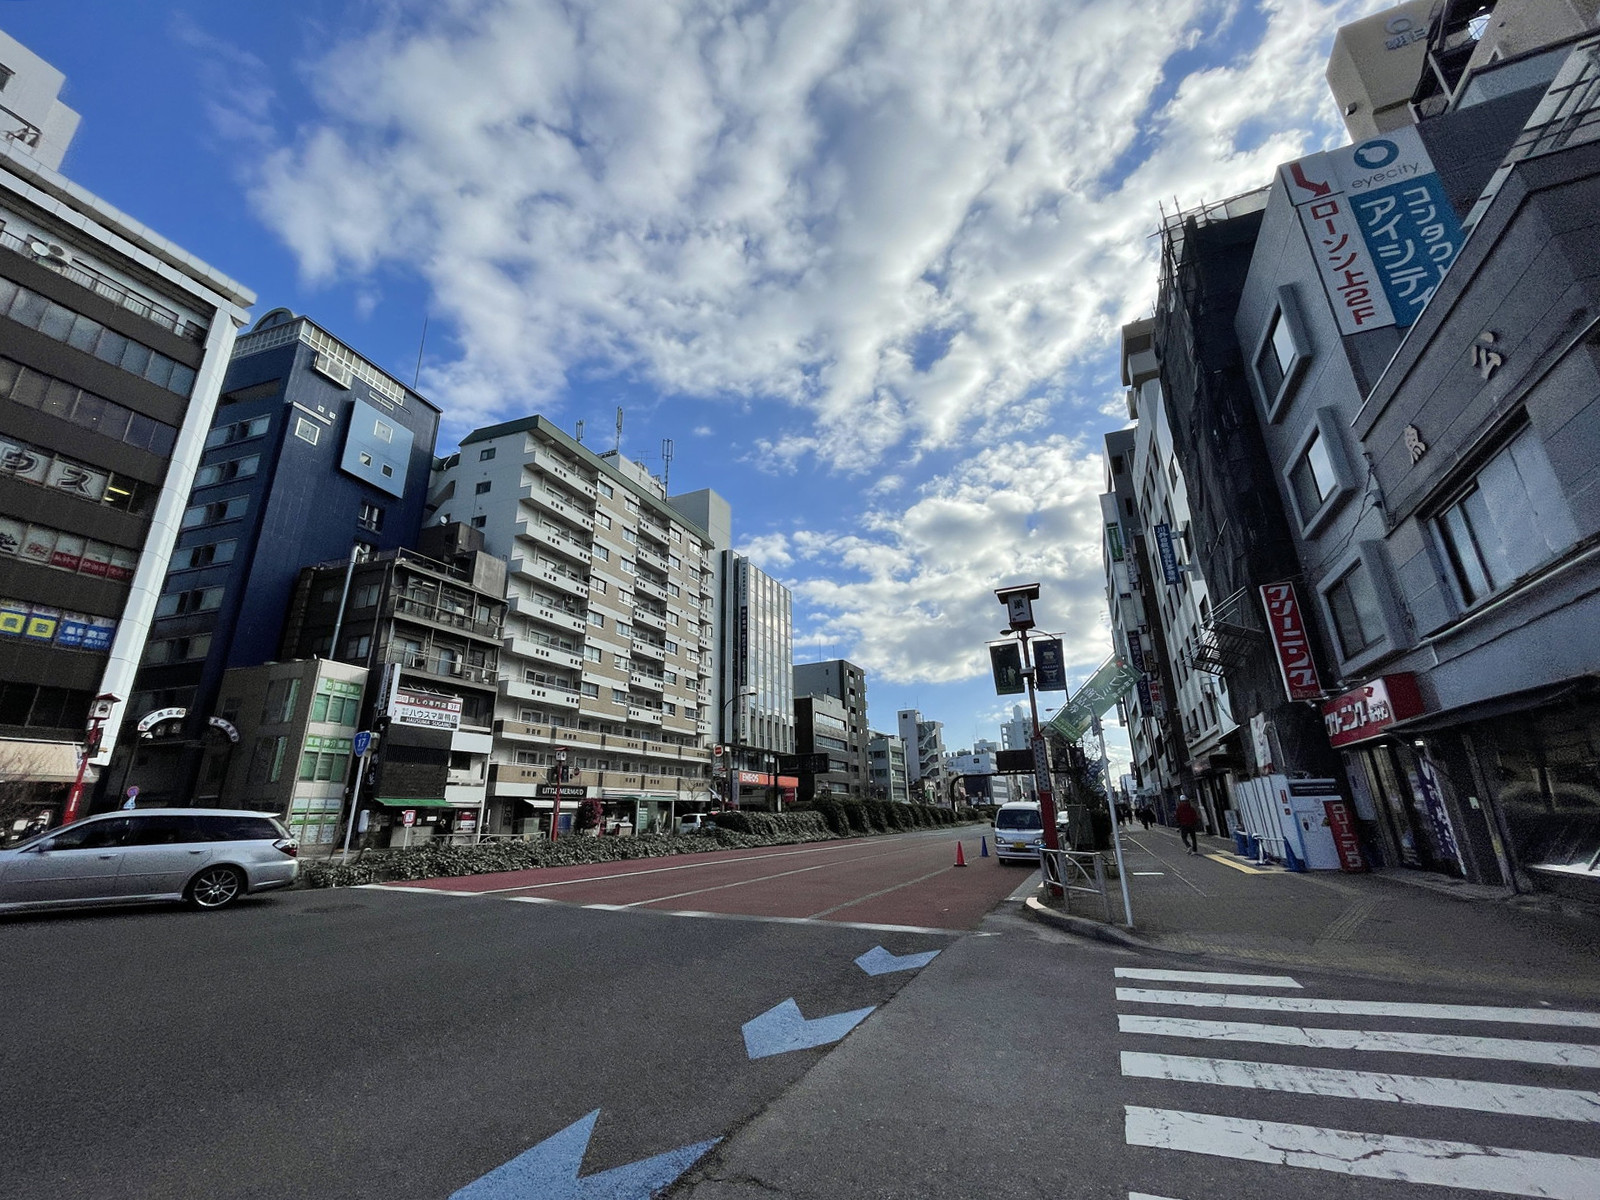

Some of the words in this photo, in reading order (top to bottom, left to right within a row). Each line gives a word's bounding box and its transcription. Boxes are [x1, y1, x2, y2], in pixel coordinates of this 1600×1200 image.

[1351, 161, 1420, 190] eyecity
[1266, 584, 1316, 688] クリーニング
[358, 738, 367, 747] 17
[741, 772, 760, 783] ENEOS
